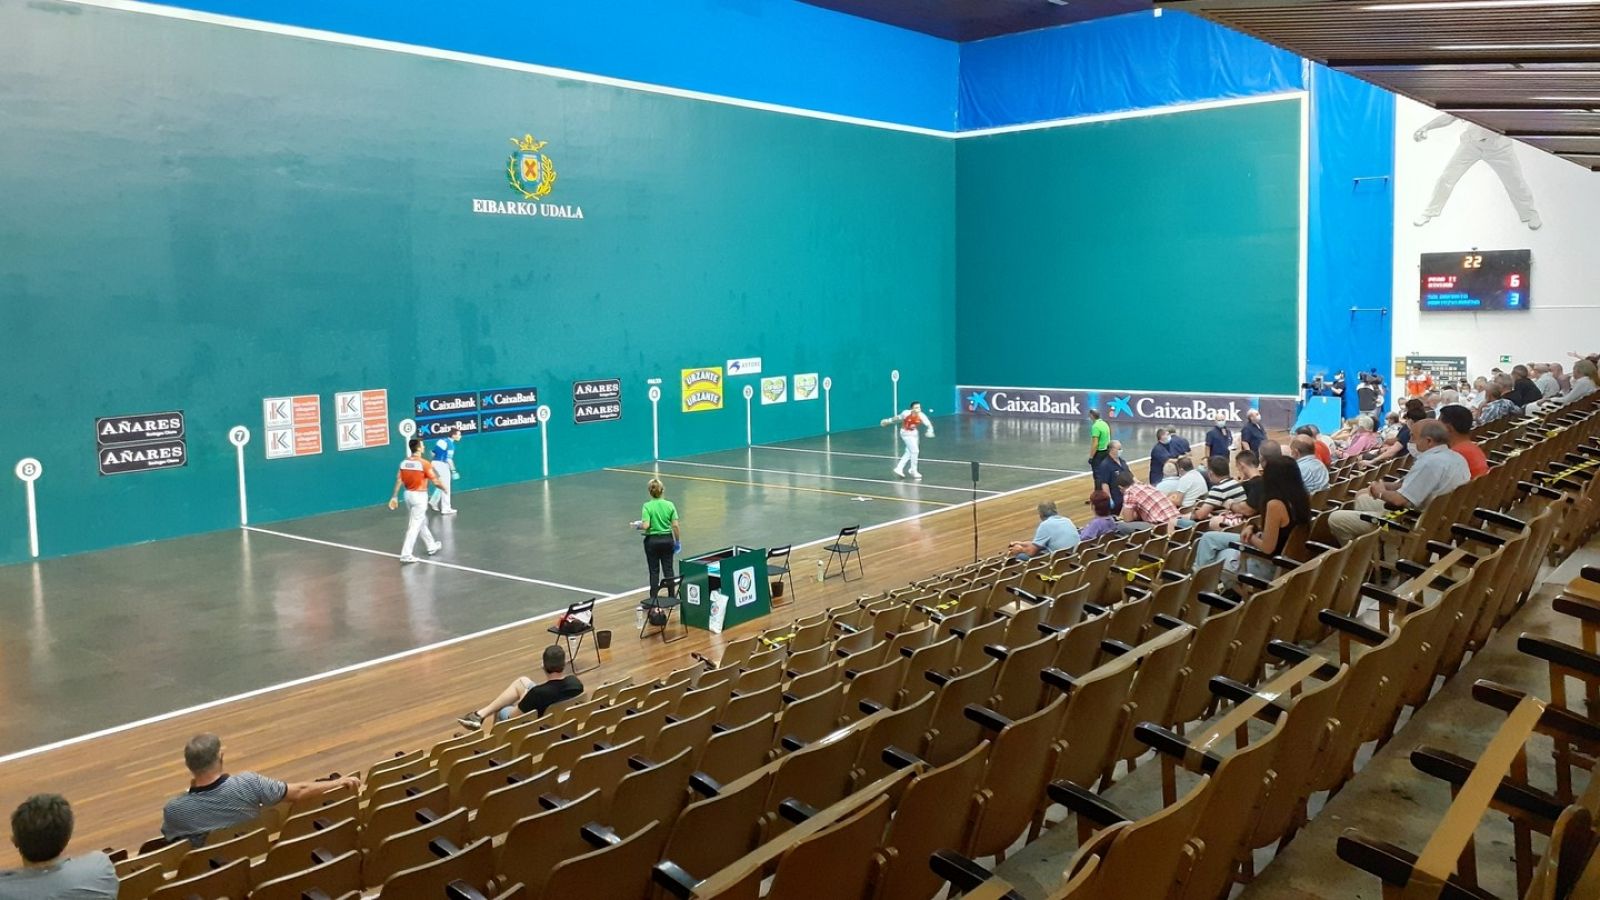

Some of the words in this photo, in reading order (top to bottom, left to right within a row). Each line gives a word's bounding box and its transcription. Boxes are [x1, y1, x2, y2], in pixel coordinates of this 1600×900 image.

[473, 198, 537, 216] EIBARKO
[540, 203, 584, 219] UDALA
[1463, 255, 1482, 269] 22
[1509, 274, 1521, 288] 6
[1509, 292, 1520, 305] 3
[686, 371, 720, 385] URZANTE
[576, 383, 619, 395] AÑARES
[429, 397, 476, 411] CaixaBank
[493, 392, 536, 405] CaixaBank
[687, 391, 720, 406] URZANTE
[991, 392, 1082, 415] CaixaBank
[576, 404, 620, 417] AÑARES
[1136, 397, 1243, 422] CaixaBank
[100, 418, 181, 436] AÑARES
[494, 413, 537, 427] CaixaBank
[235, 430, 245, 442] 7
[103, 447, 183, 465] AÑARES
[23, 463, 36, 476] 8
